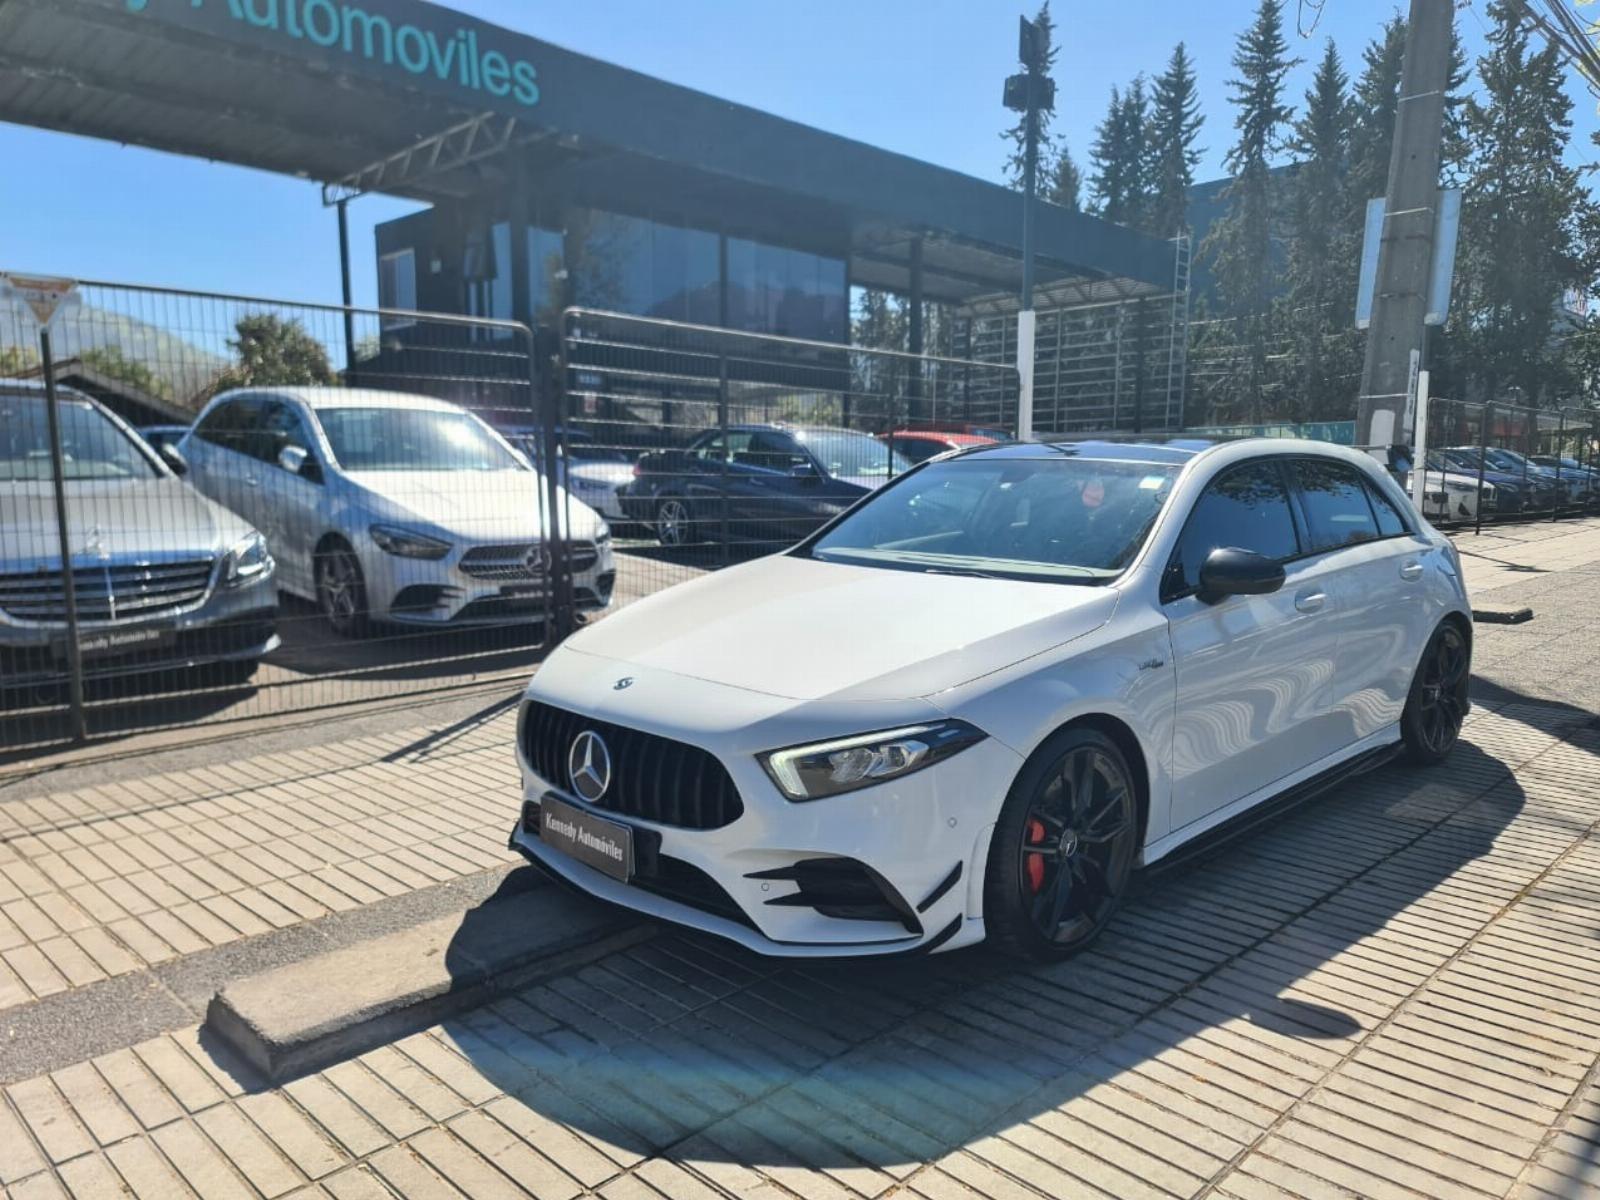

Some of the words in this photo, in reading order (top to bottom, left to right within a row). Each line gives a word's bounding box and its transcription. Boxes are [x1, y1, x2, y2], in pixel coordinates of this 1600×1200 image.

[190, 0, 539, 105] utomoviles
[545, 811, 577, 843] Kennedy
[577, 826, 623, 862] Automóviles
